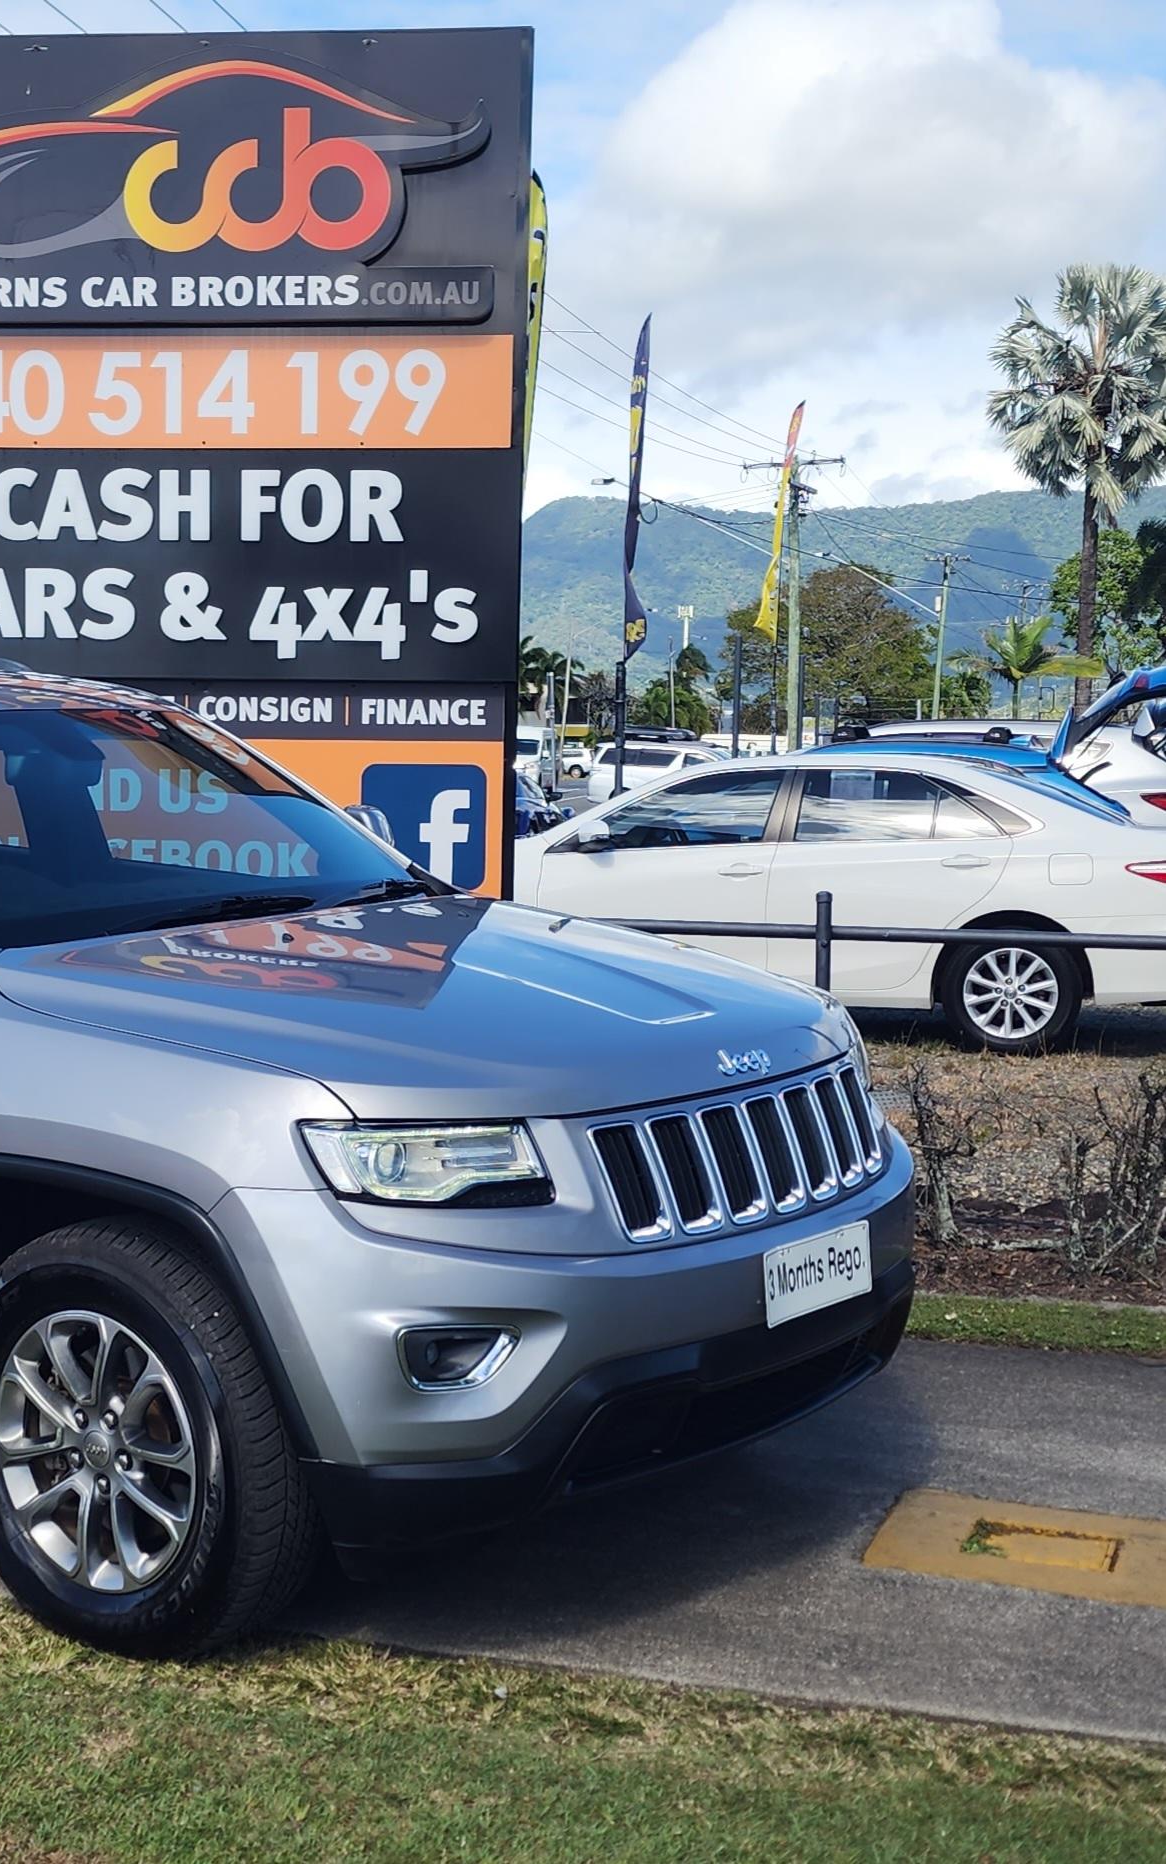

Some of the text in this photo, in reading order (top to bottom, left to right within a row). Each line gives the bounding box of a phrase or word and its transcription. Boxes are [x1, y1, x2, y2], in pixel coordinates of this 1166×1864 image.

[81, 276, 158, 308] CAR
[88, 350, 255, 436] 514
[286, 348, 447, 436] 199
[240, 468, 404, 543] FOR
[159, 571, 227, 641] &
[198, 696, 487, 726] CONSIGN FINANCE
[159, 768, 228, 814] US
[716, 1048, 771, 1076] Jeep
[768, 1246, 866, 1301] 3 Months Rego.
